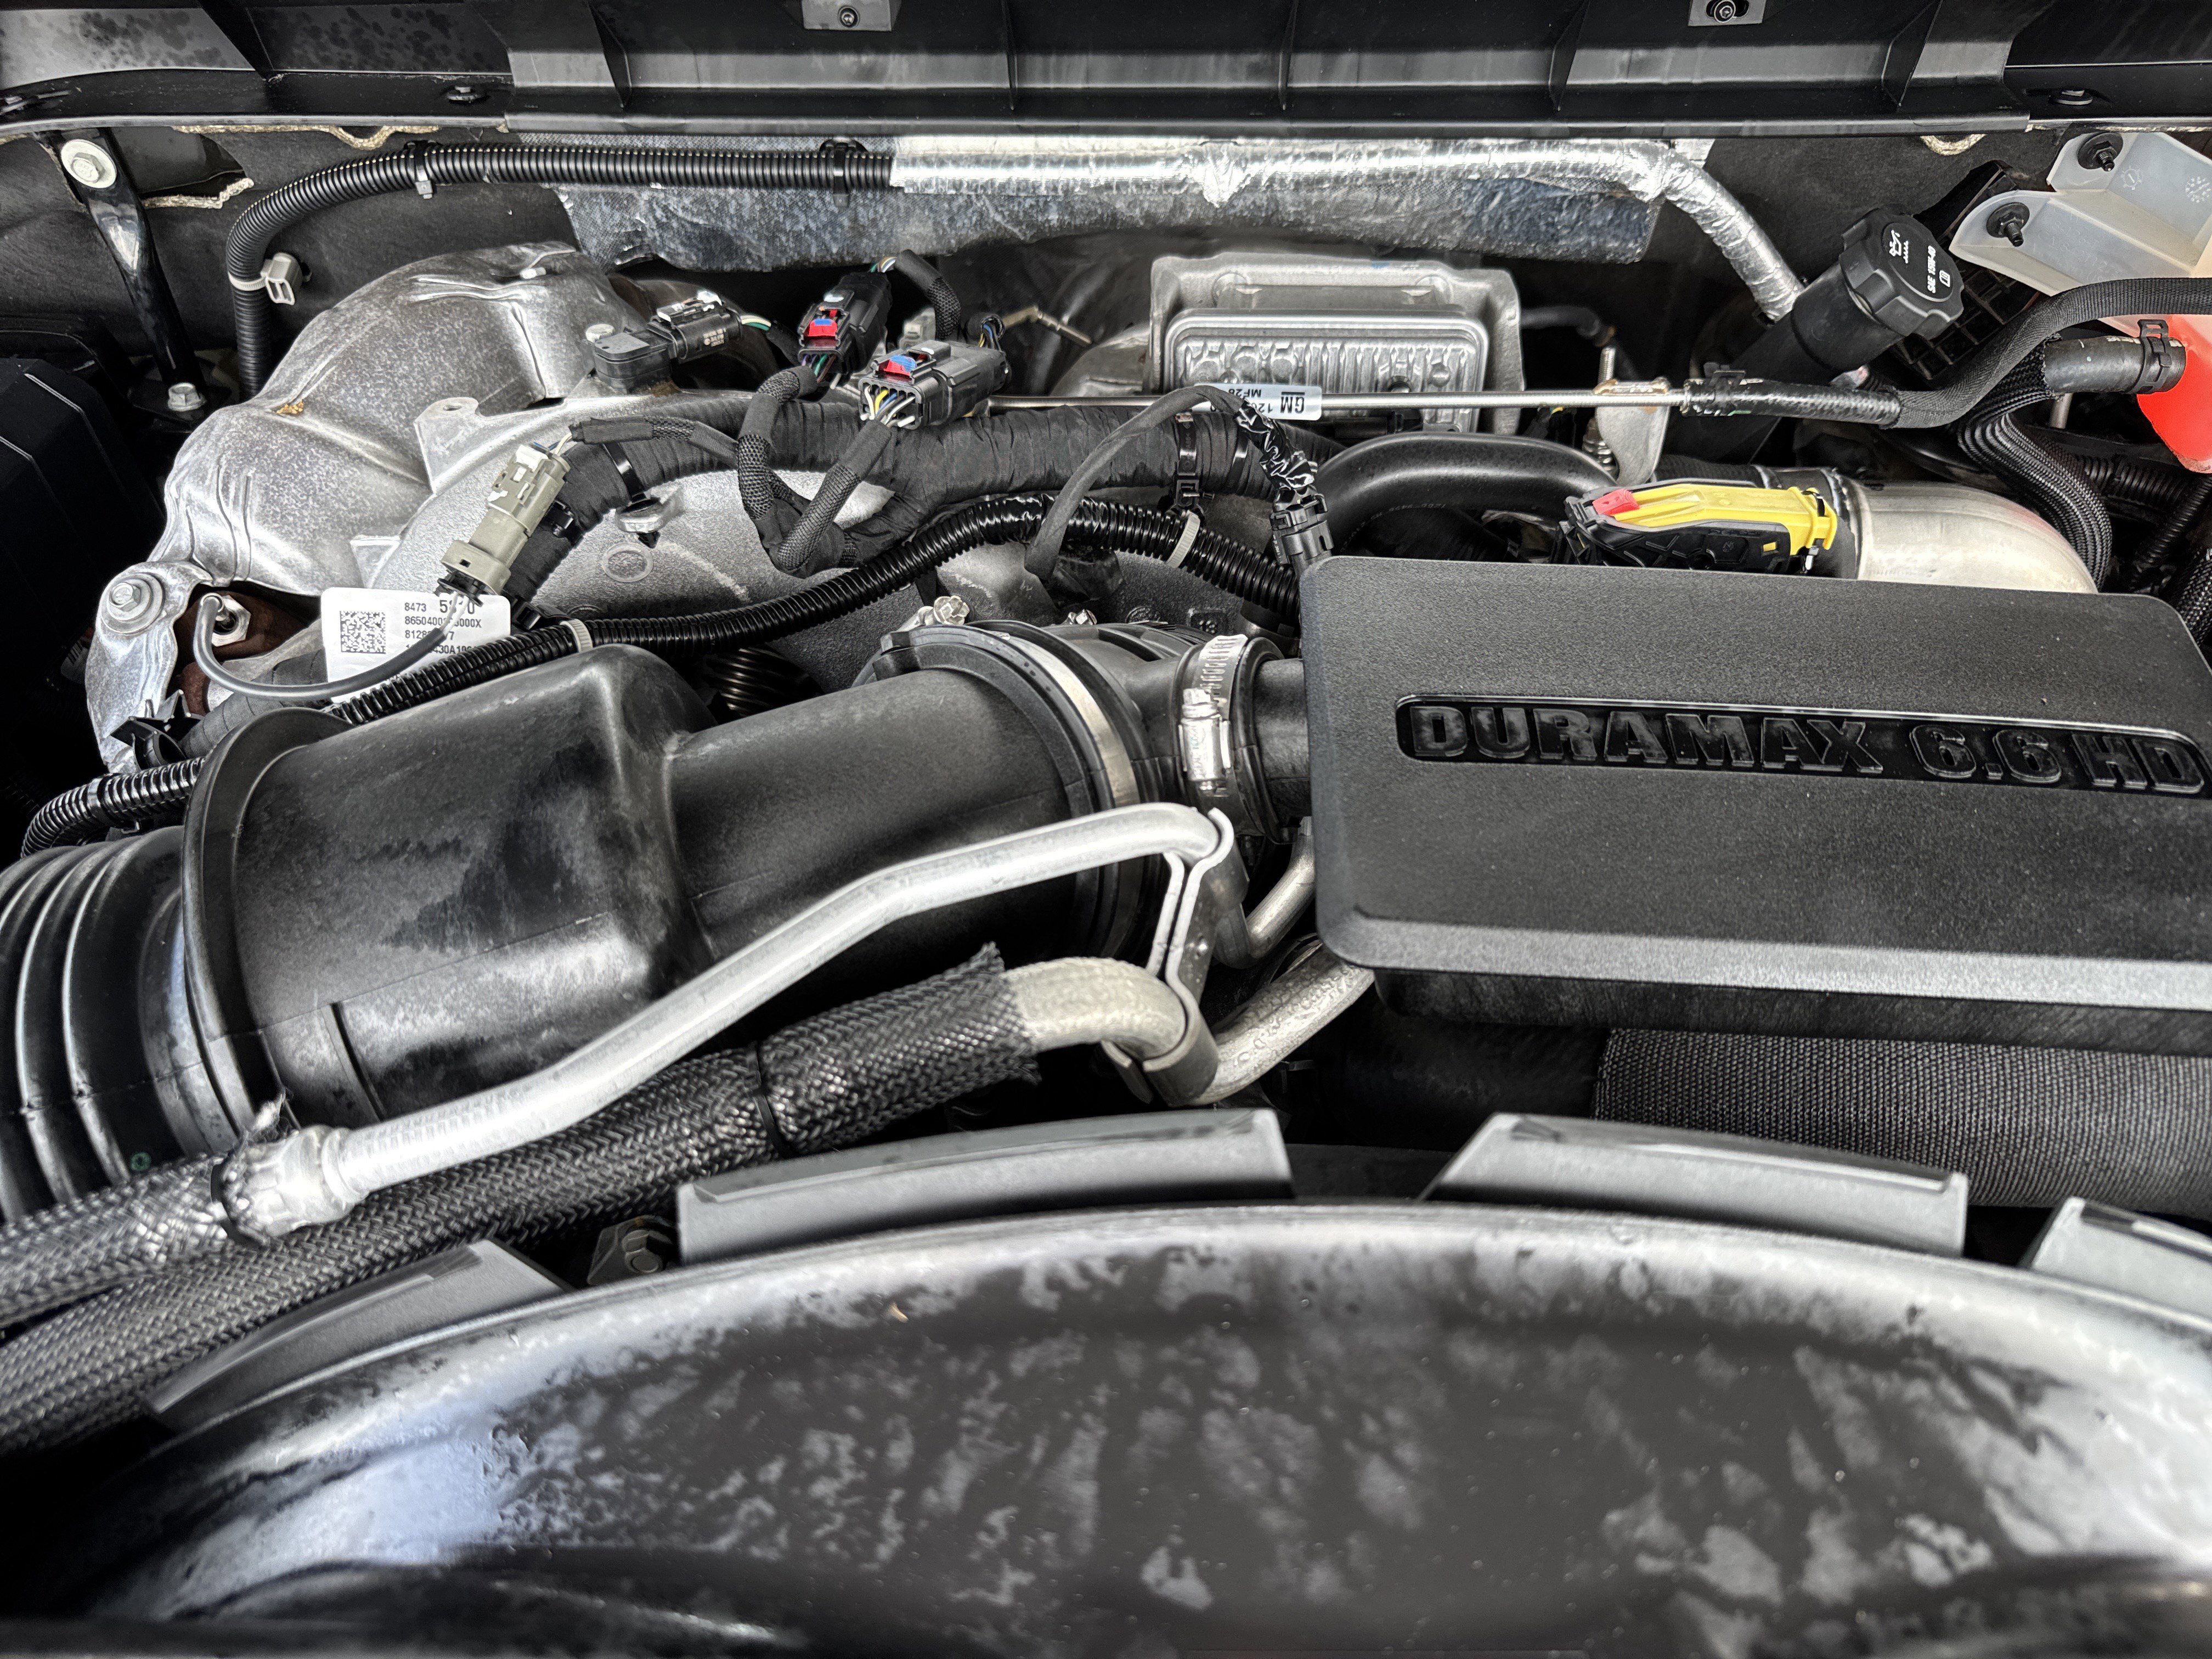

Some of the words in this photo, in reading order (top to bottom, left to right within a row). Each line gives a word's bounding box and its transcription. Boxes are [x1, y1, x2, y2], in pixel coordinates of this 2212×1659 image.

[1927, 275, 1936, 294] SAE
[1280, 396, 1305, 414] GM
[404, 602, 427, 612] 8473
[439, 600, 475, 614] 50
[1409, 706, 1883, 774] DURAMAX
[1909, 724, 2062, 784] 6.6
[2069, 730, 2205, 794] HD
